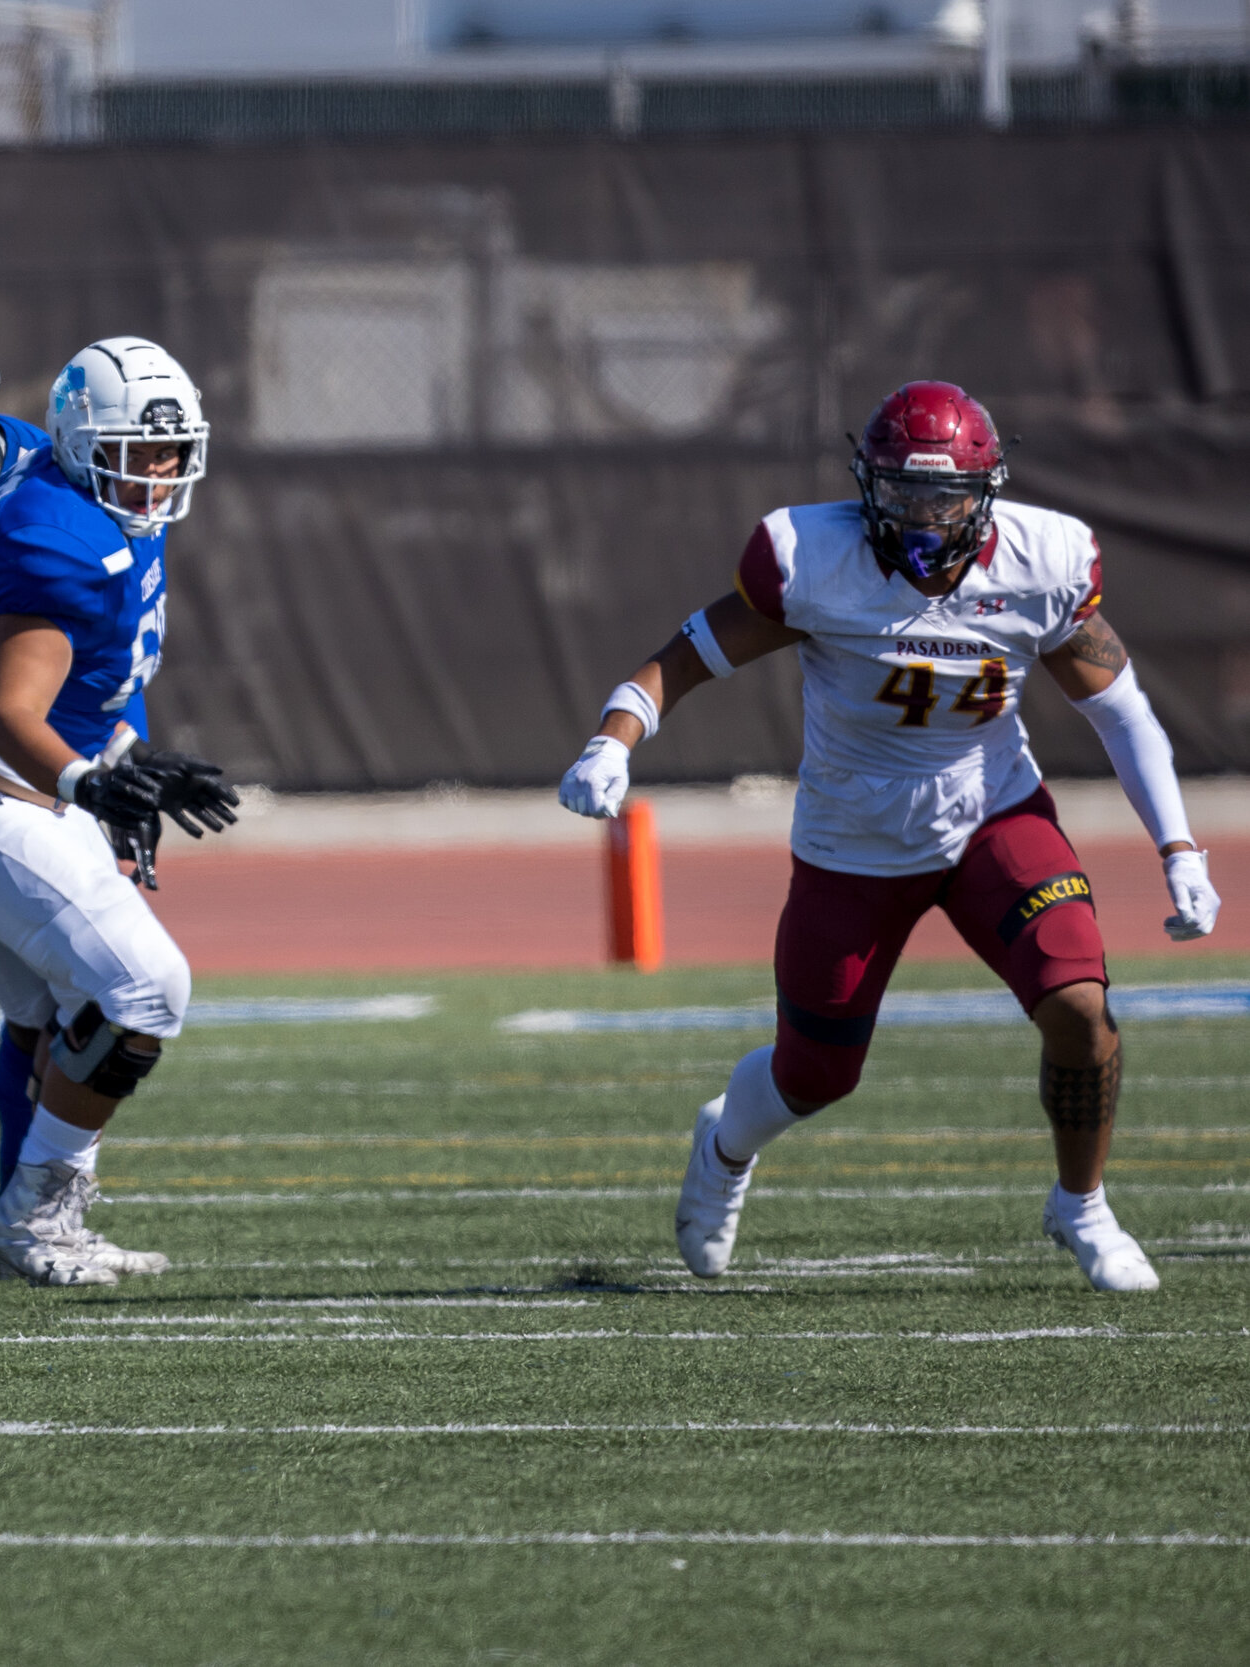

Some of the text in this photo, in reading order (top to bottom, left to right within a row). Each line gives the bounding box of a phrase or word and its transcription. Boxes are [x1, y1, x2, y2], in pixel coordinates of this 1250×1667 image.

[896, 641, 992, 657] PASADENA
[874, 656, 1009, 728] 44
[1019, 876, 1090, 919] LANCERS
